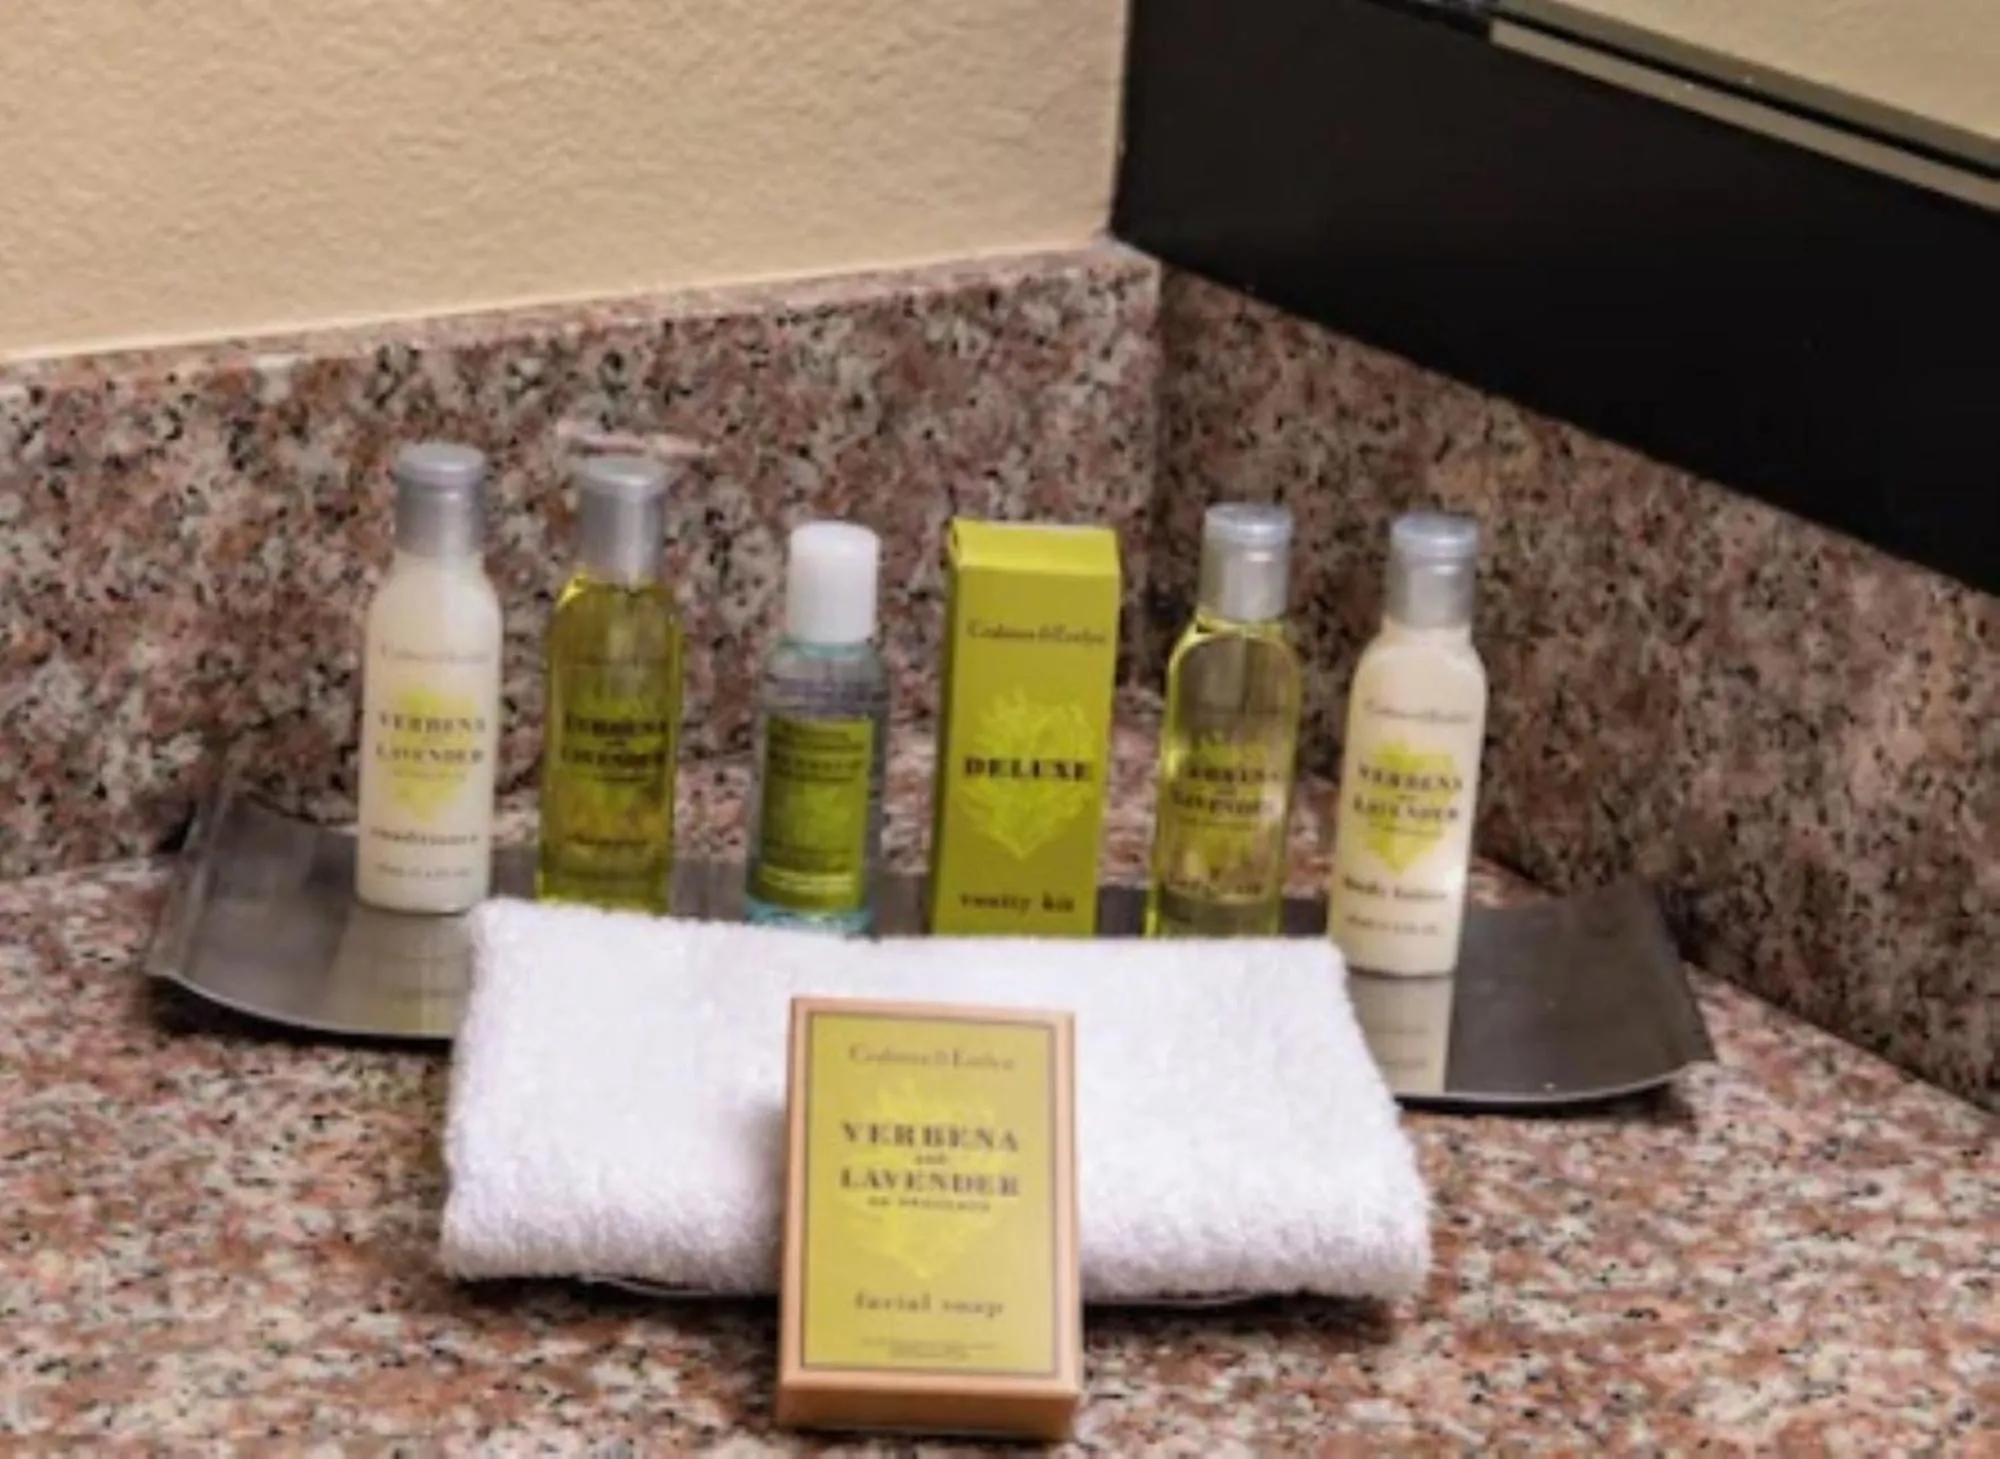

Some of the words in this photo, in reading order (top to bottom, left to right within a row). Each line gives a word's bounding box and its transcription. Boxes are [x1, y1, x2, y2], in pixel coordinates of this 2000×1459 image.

[963, 756, 1094, 782] DELUXE
[841, 1122, 1019, 1151] VERBENA
[840, 1168, 1020, 1197] LAVENDER
[854, 1289, 931, 1312] facial
[940, 1299, 1004, 1318] soap
